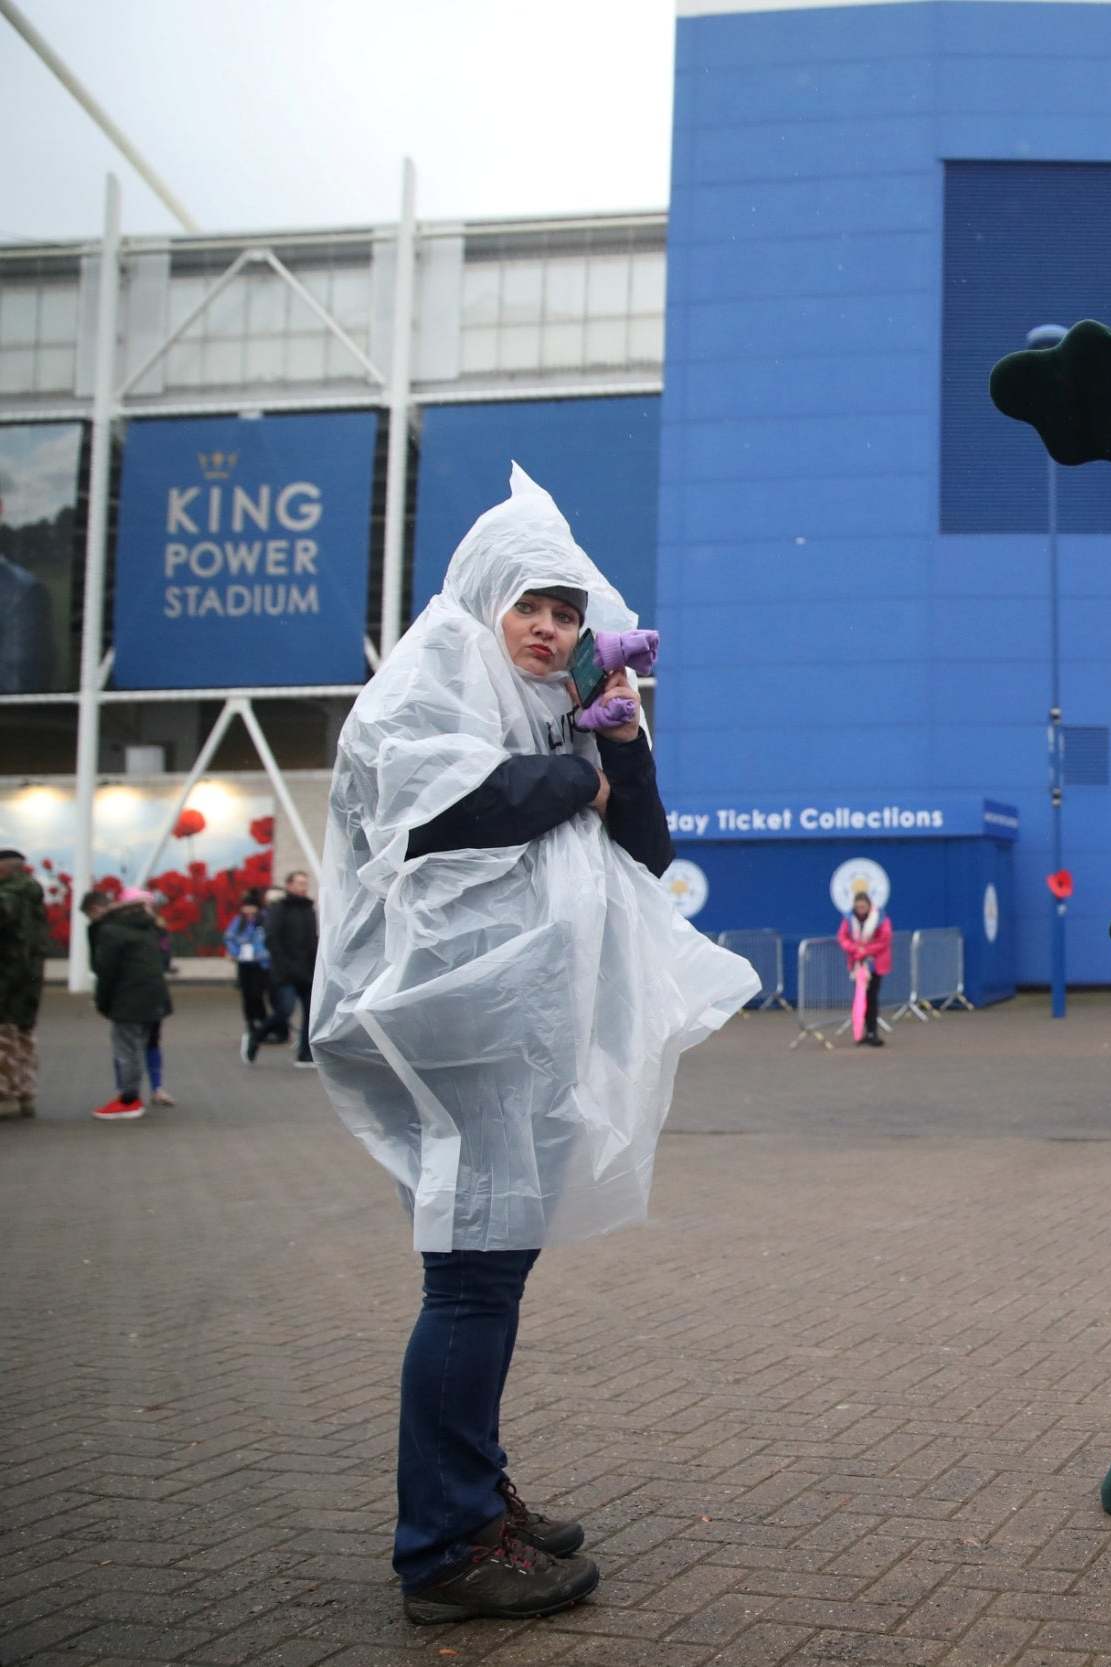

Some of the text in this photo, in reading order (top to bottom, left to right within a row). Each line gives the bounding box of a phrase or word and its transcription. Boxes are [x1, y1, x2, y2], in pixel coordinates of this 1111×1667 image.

[167, 481, 323, 534] KING
[165, 539, 320, 578] POWER
[164, 585, 320, 618] STADIUM
[717, 809, 792, 832] Ticket
[800, 808, 943, 831] Collections
